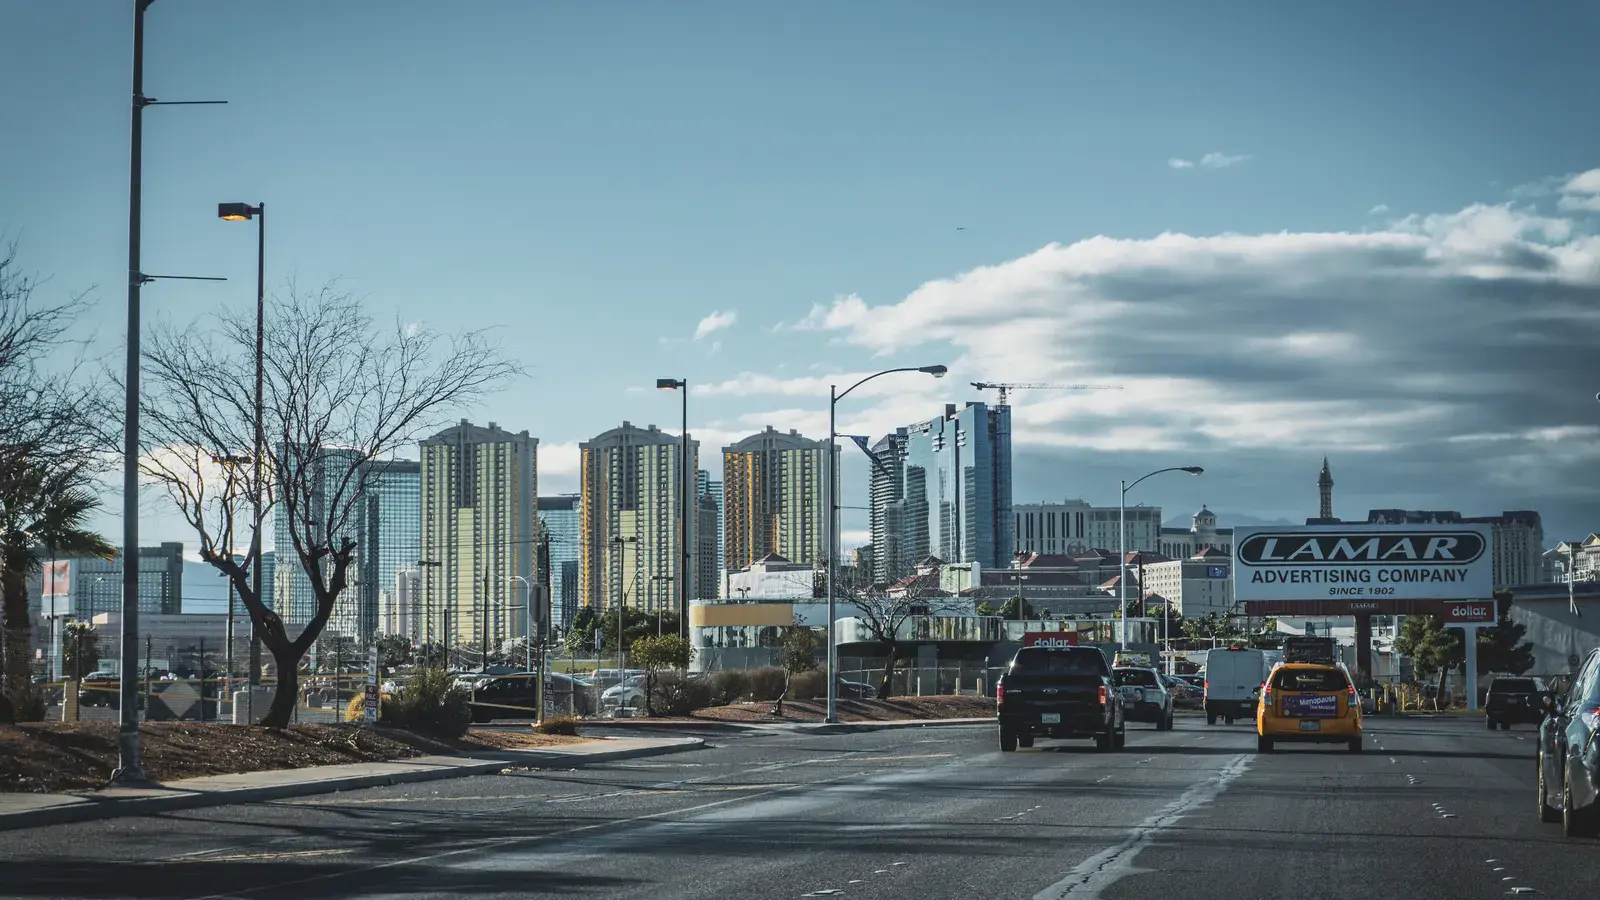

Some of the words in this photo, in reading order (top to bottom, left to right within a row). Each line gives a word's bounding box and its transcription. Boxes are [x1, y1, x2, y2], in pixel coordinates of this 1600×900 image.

[1259, 537, 1459, 560] LAMAR
[1251, 569, 1371, 584] ADVERTISING
[1377, 568, 1469, 583] COMPANY
[1328, 587, 1364, 595] SINCE
[1368, 587, 1395, 595] 1902
[1299, 695, 1336, 706] Menopause
